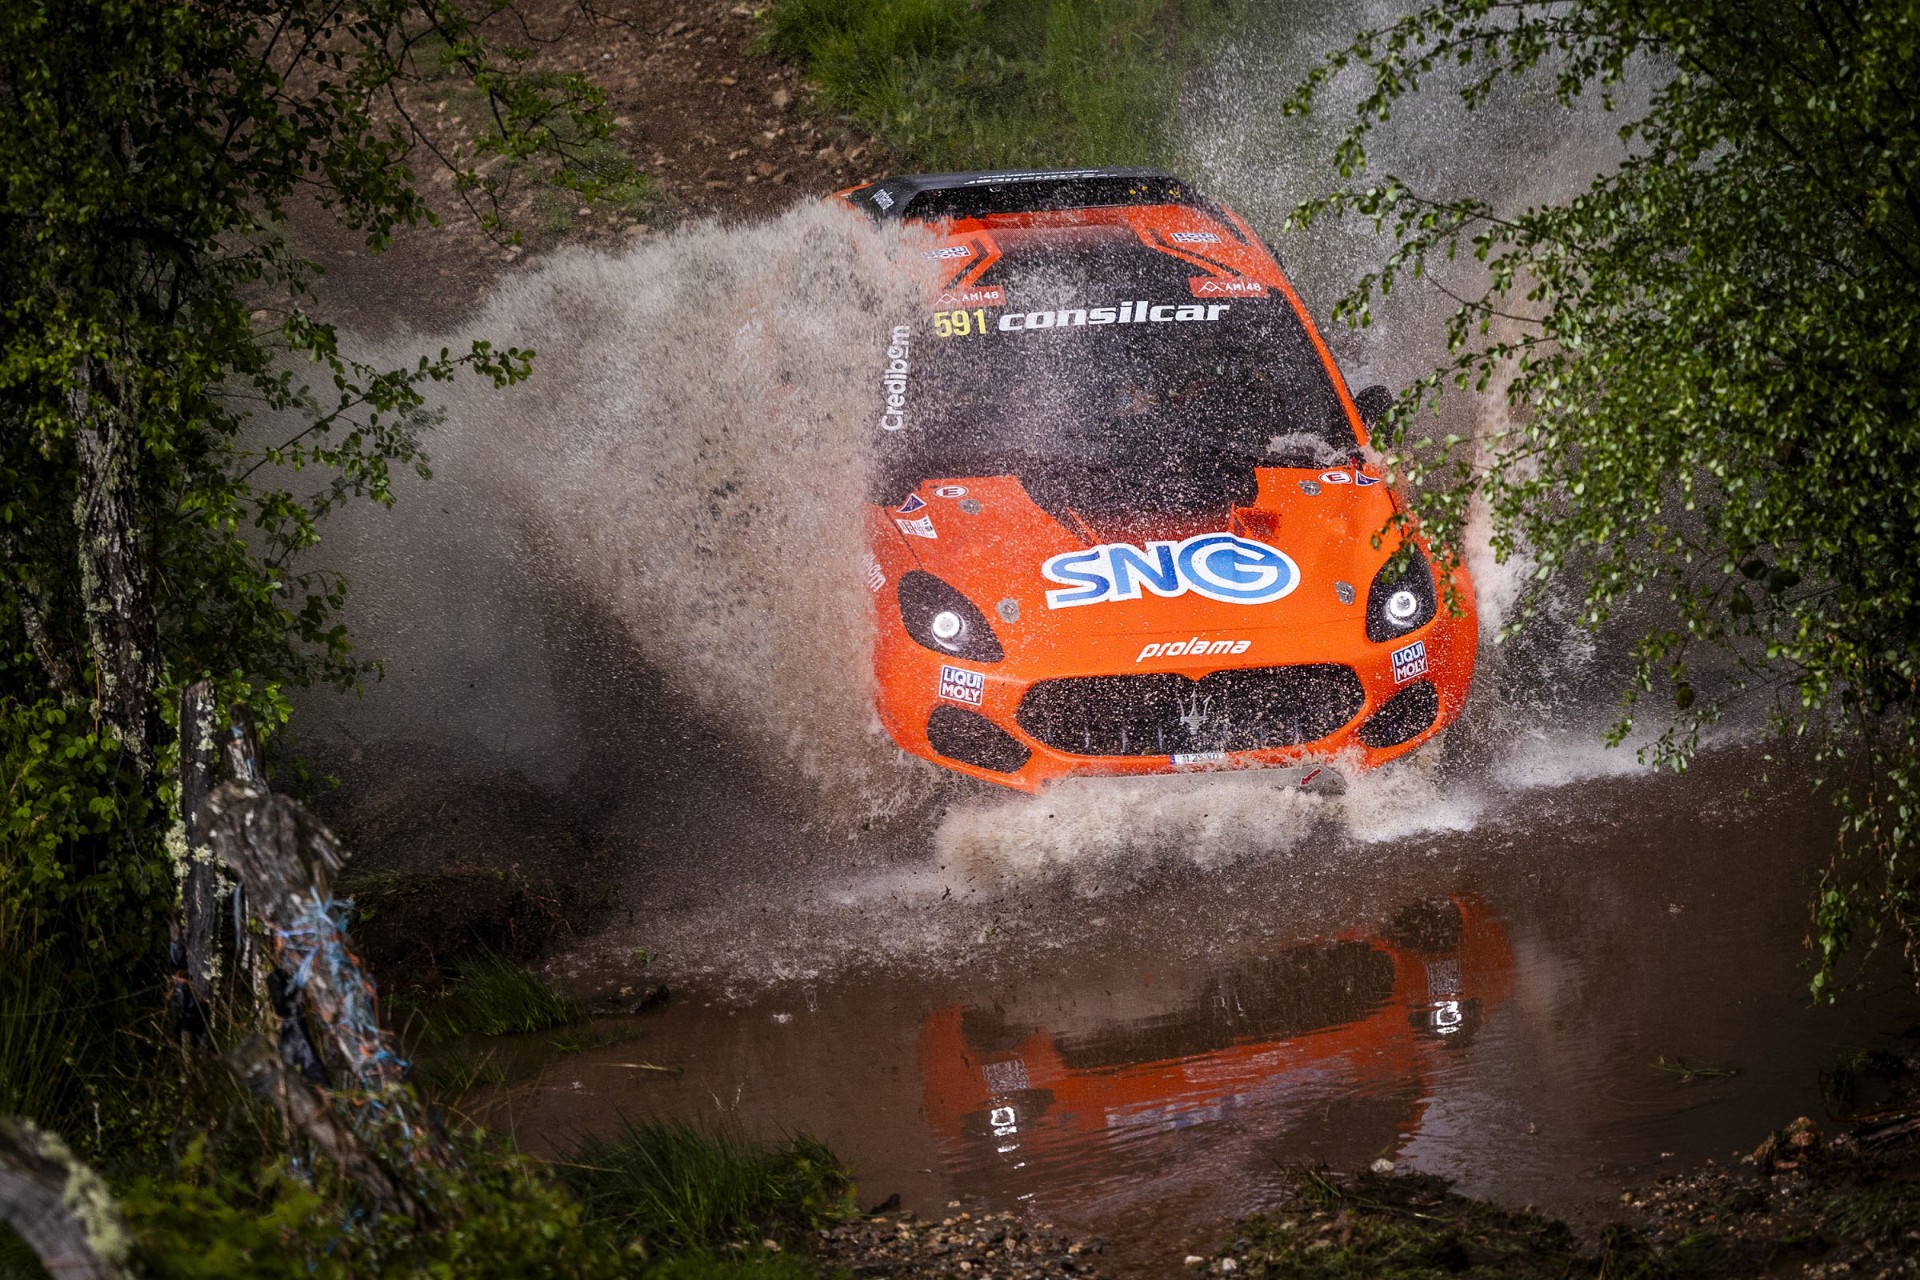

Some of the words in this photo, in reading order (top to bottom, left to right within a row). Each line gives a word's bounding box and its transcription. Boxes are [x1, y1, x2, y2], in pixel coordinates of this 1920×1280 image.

[934, 309, 987, 337] 591
[999, 301, 1230, 331] consilcar
[881, 325, 910, 431] Credibom
[1045, 533, 1298, 607] SNG
[1135, 636, 1252, 663] prolama
[1393, 643, 1424, 667] LIQUI
[943, 667, 983, 689] LIQUI
[1396, 657, 1426, 681] MOLY
[941, 682, 982, 702] MOLY
